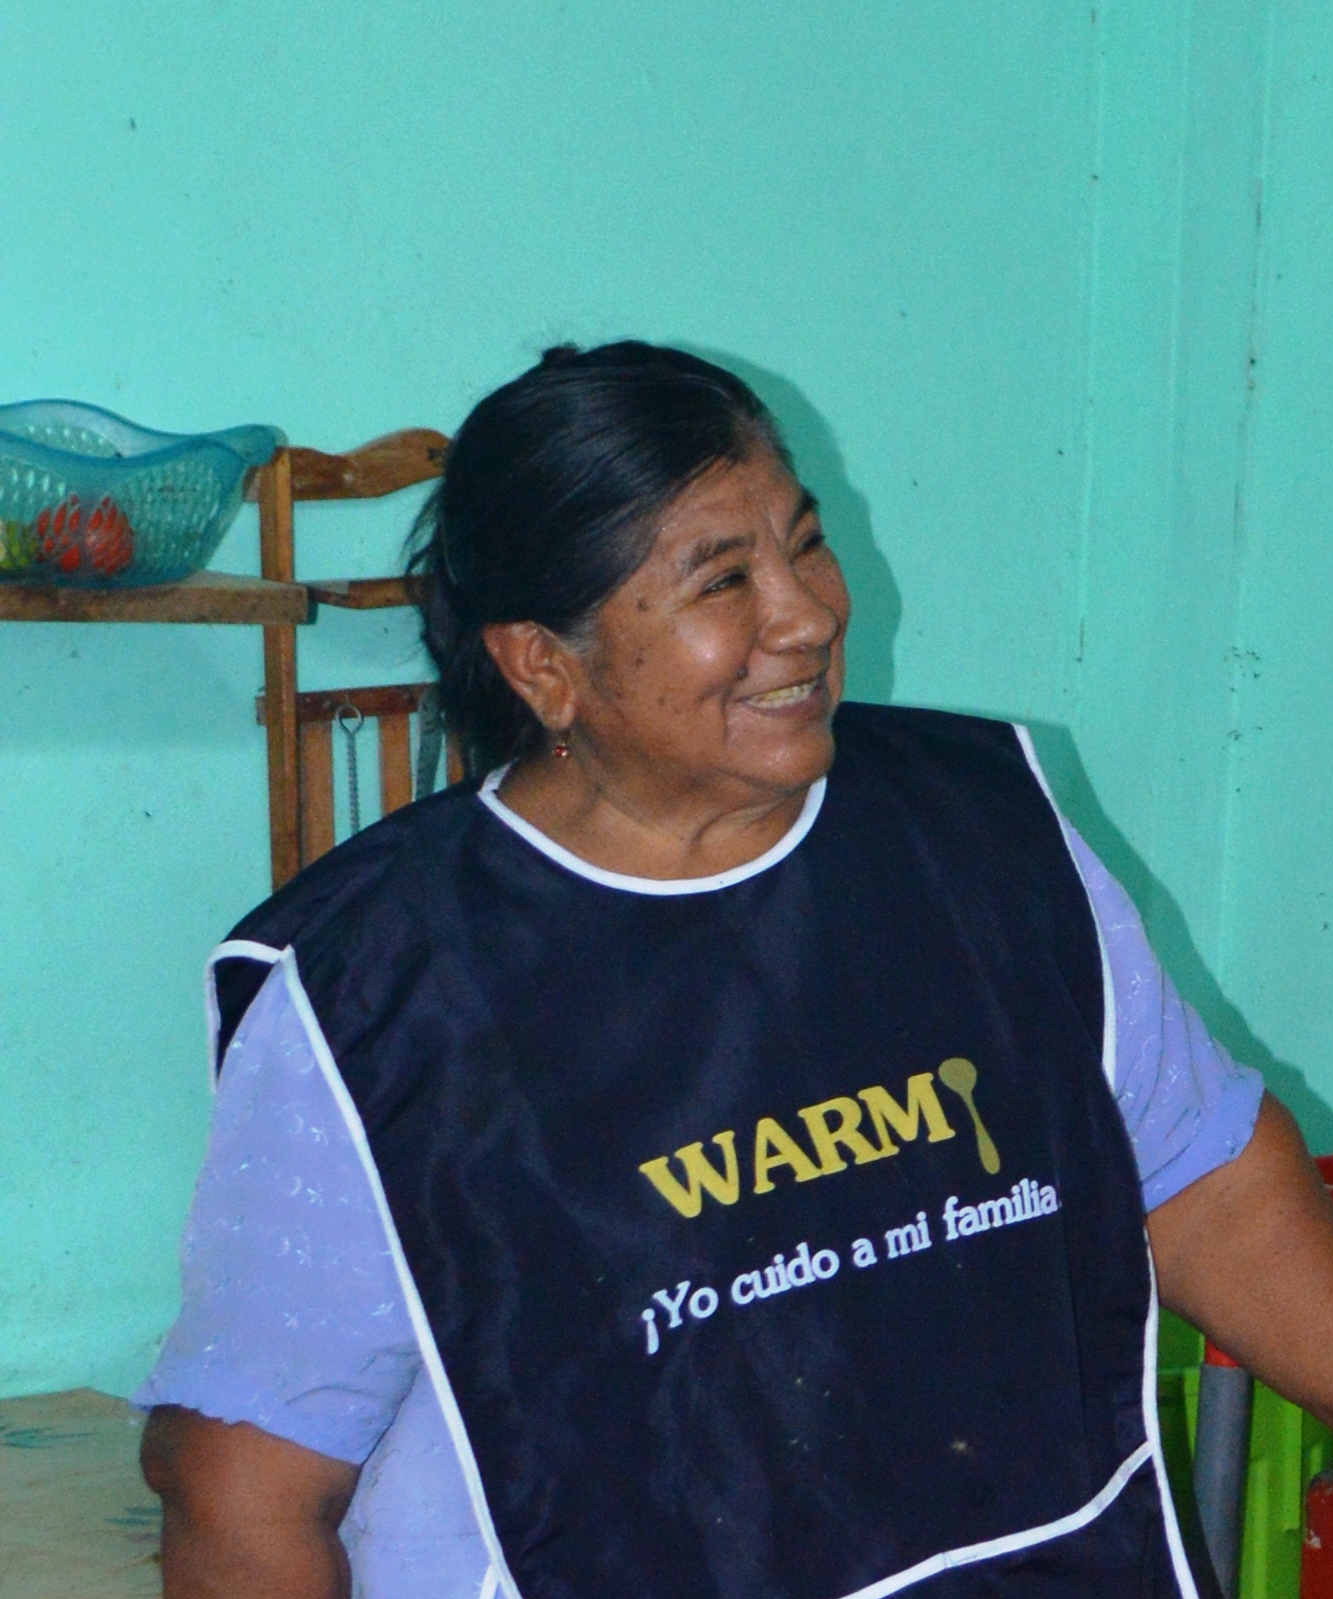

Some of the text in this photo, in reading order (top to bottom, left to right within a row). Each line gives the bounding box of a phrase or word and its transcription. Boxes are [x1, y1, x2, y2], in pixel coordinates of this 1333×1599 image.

[641, 1177, 1059, 1355] ¡Yo cuido a mi familia
